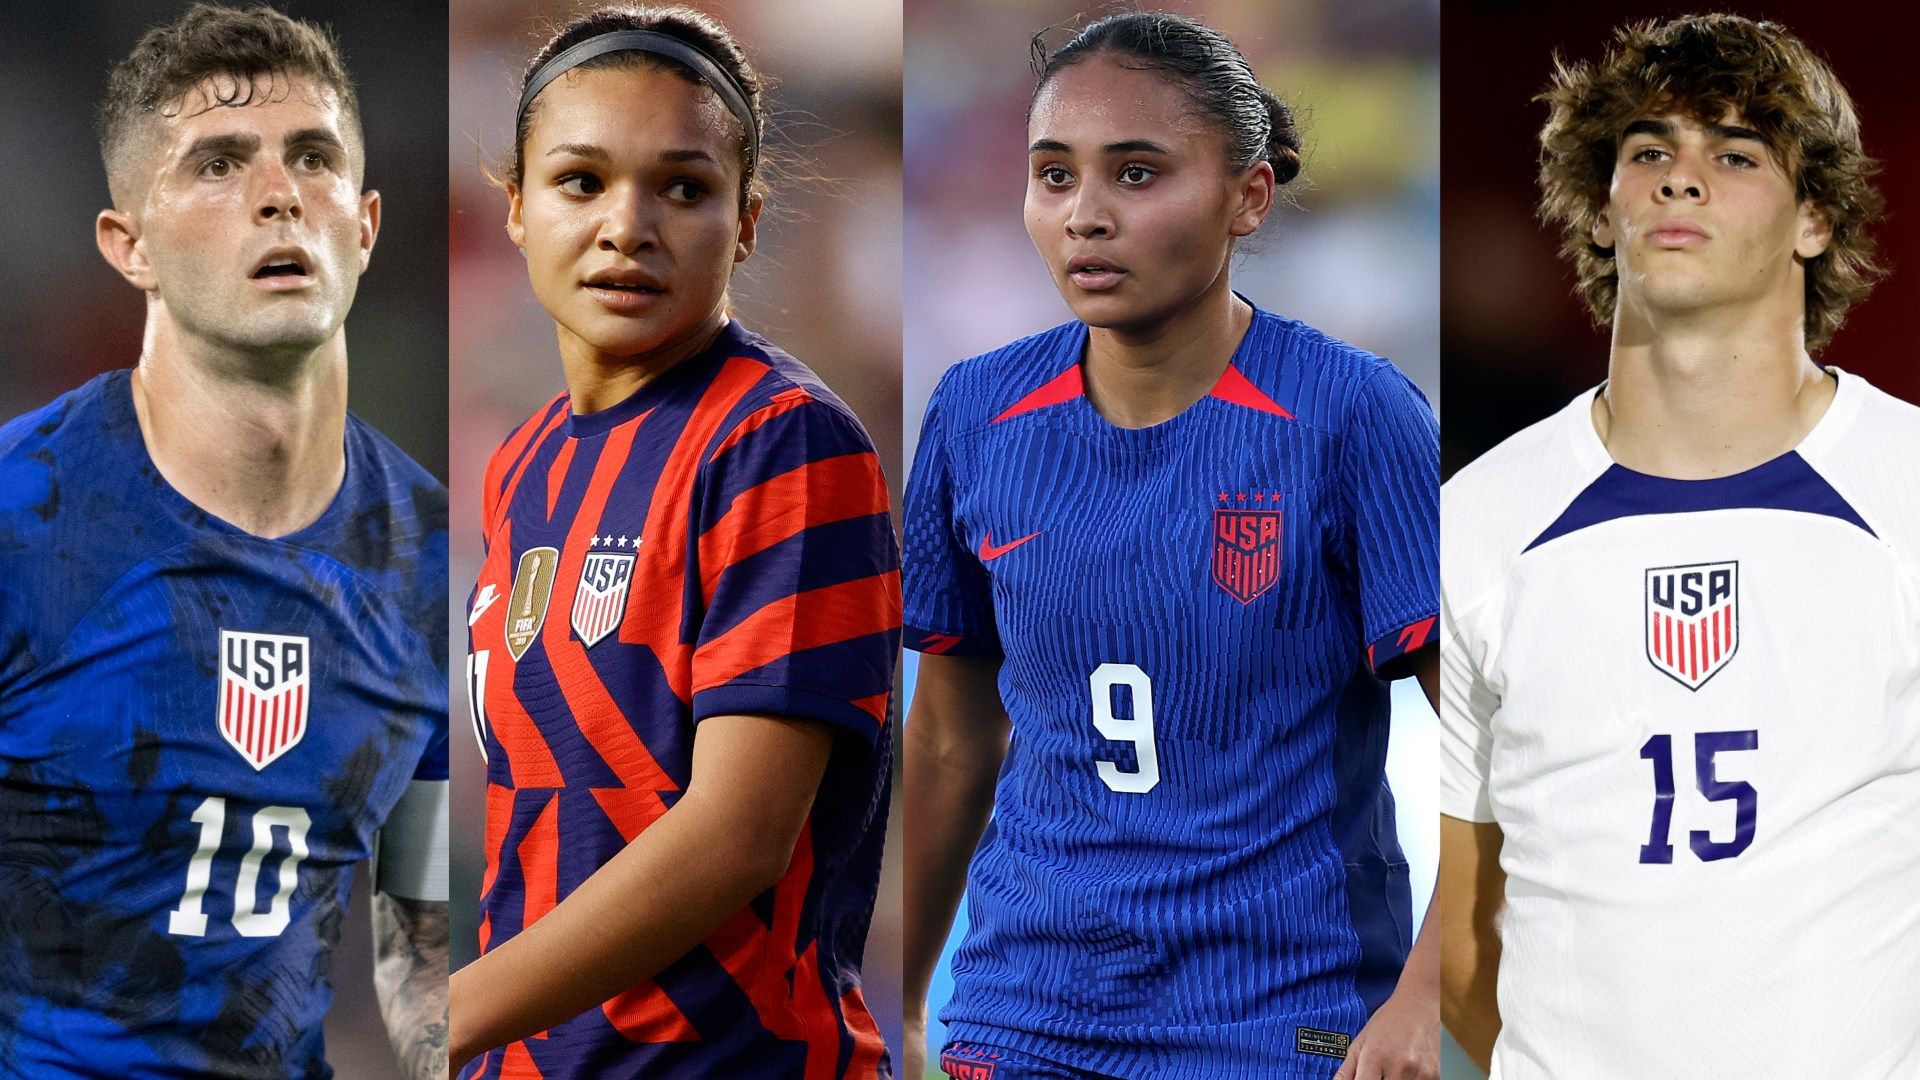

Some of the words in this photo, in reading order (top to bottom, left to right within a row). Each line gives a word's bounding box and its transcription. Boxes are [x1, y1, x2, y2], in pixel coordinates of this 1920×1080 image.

[1219, 515, 1277, 551] USA
[583, 558, 630, 592] USA
[1653, 569, 1731, 617] USA
[514, 618, 533, 633] FIFA
[227, 637, 304, 691] USA
[1089, 663, 1160, 794] 9
[1639, 729, 1758, 864] 15
[168, 796, 312, 937] 10
